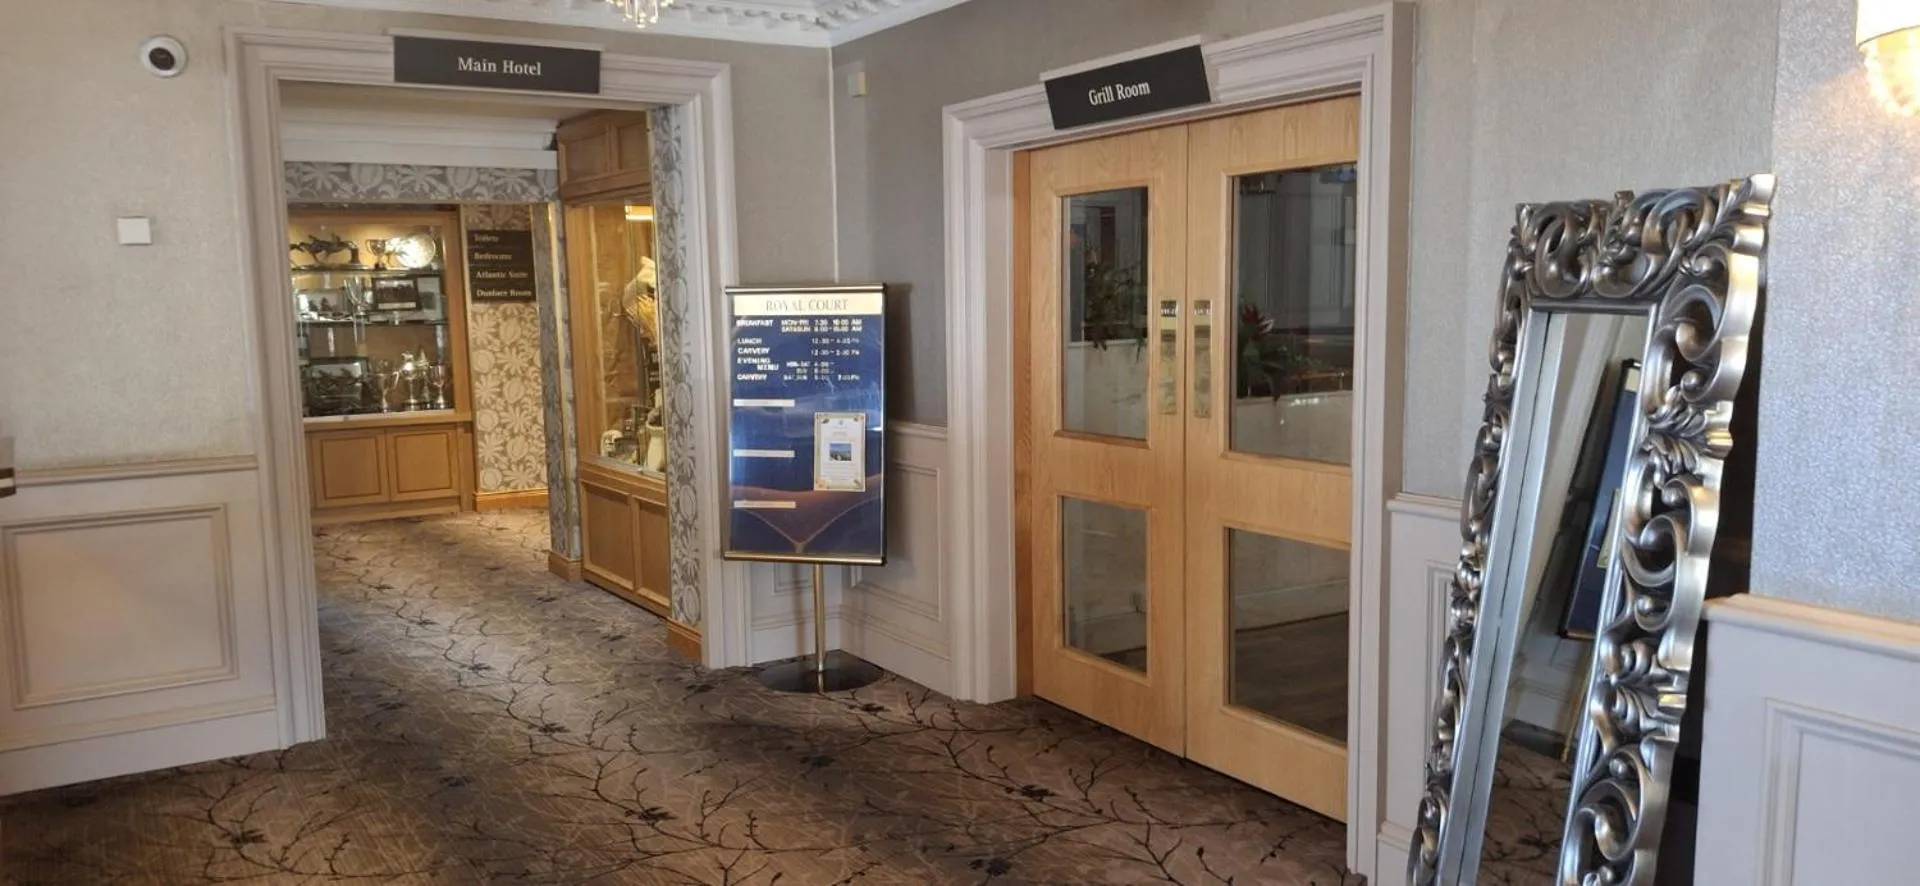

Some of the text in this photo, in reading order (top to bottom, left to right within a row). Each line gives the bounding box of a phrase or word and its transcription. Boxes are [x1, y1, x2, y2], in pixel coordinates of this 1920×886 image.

[457, 56, 541, 75] Main Hotel
[1088, 81, 1151, 106] Grill Room
[476, 271, 506, 279] Atlantic
[510, 289, 532, 297] Room
[765, 299, 848, 313] ROYAL COURT
[736, 319, 774, 328] BREAKFAST
[737, 337, 762, 345] LUNCH
[737, 347, 770, 355] CARVERY
[737, 357, 771, 365] EVENING
[756, 363, 779, 371] MENU
[737, 373, 768, 381] CARVERY
